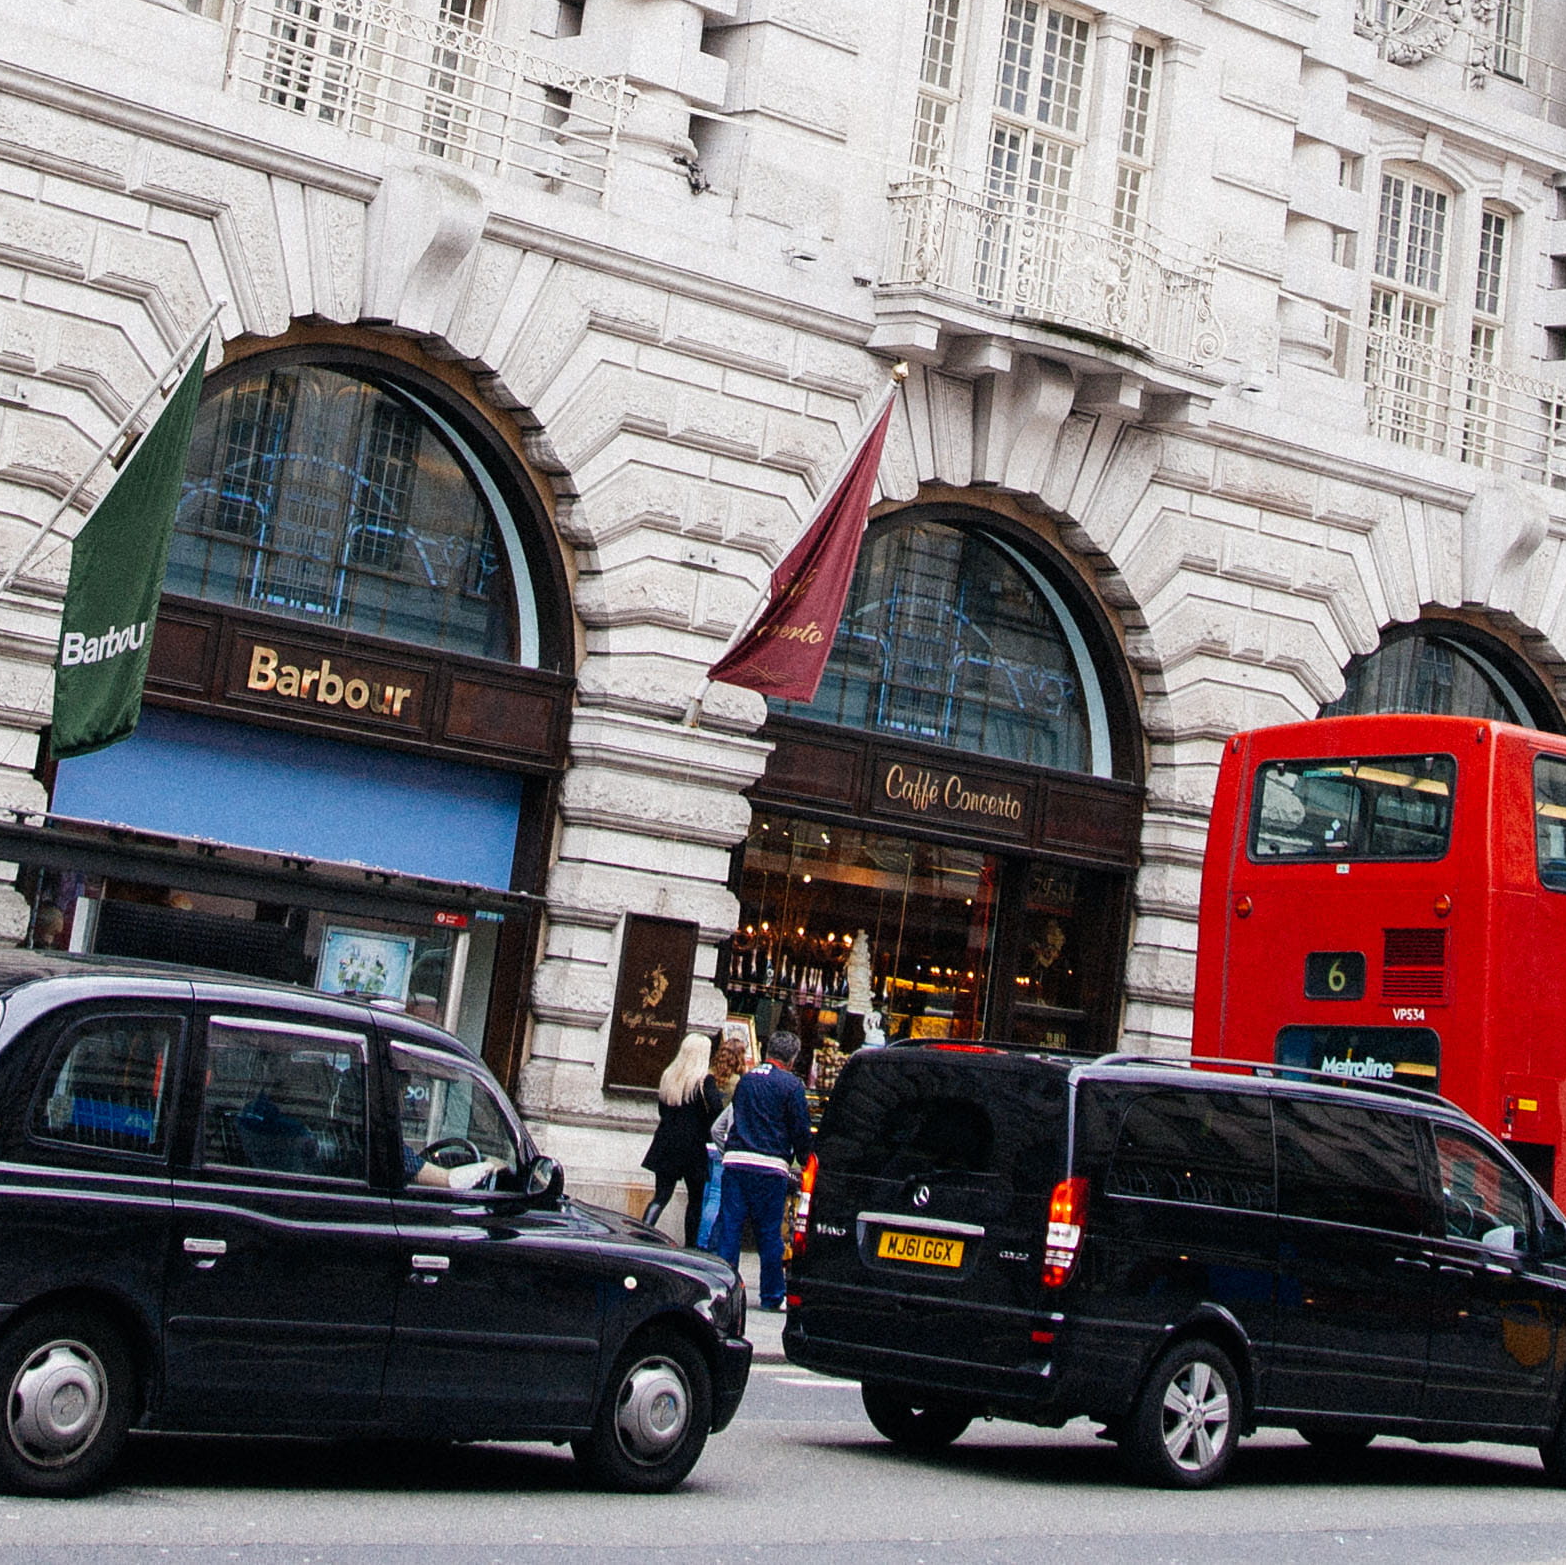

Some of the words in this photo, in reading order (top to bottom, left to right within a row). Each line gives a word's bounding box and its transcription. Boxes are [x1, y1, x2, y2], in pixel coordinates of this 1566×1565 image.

[247, 645, 412, 717] Barbour
[944, 775, 1022, 821] Concerto
[1328, 958, 1346, 992] 6
[1392, 1008, 1425, 1021] VP534
[1321, 1055, 1394, 1078] Metroline
[887, 1235, 920, 1257] MJ61
[923, 1241, 954, 1262] GGX
